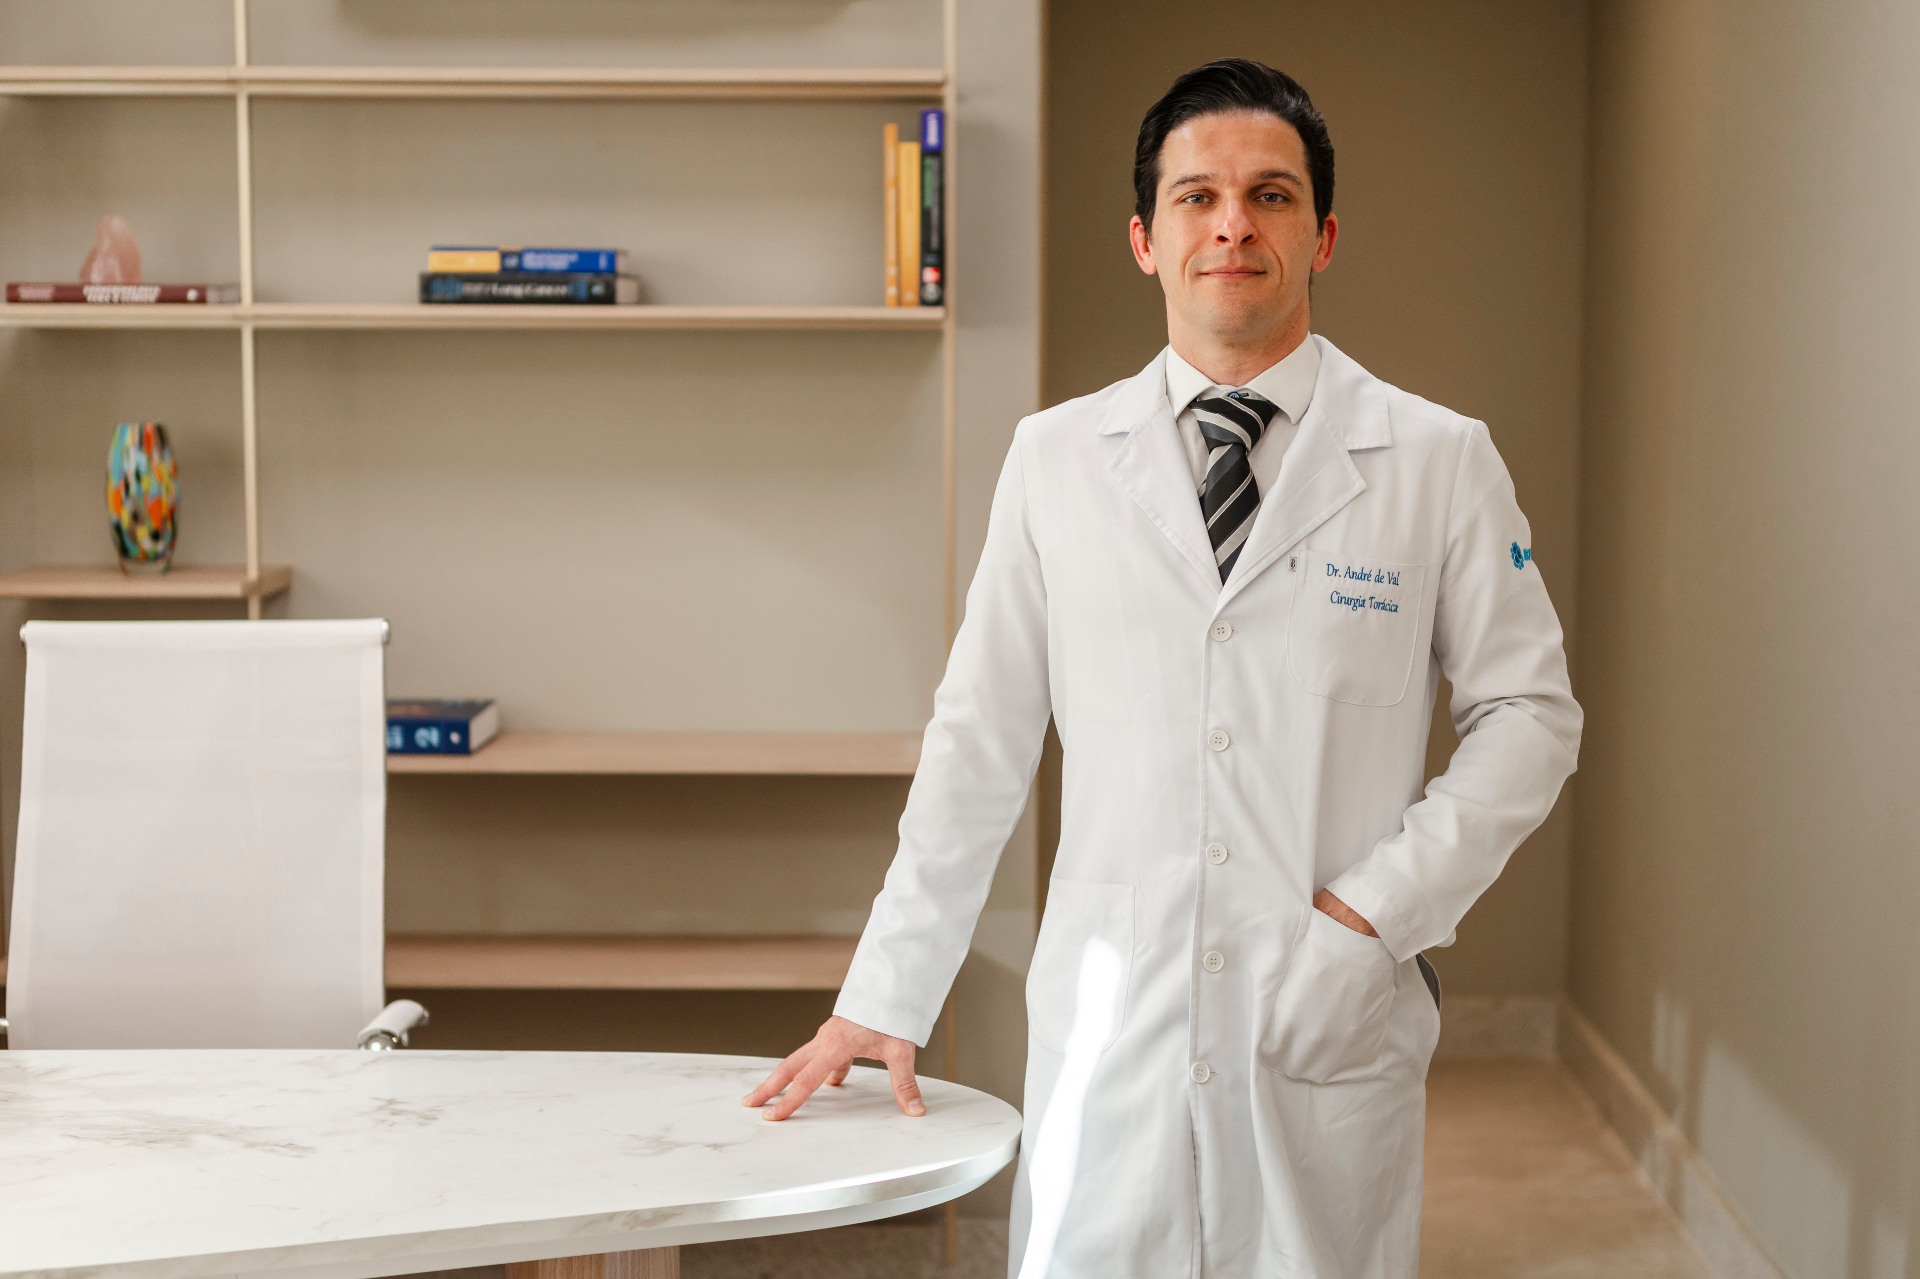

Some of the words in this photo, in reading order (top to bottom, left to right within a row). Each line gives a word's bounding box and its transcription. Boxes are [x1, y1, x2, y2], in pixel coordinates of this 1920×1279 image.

[1326, 563, 1341, 578] Dr.
[1344, 566, 1372, 582] André
[1374, 569, 1385, 584] de
[1387, 571, 1401, 586] Val
[1330, 590, 1366, 612] Cirurgia
[1369, 596, 1399, 613] Torácica
